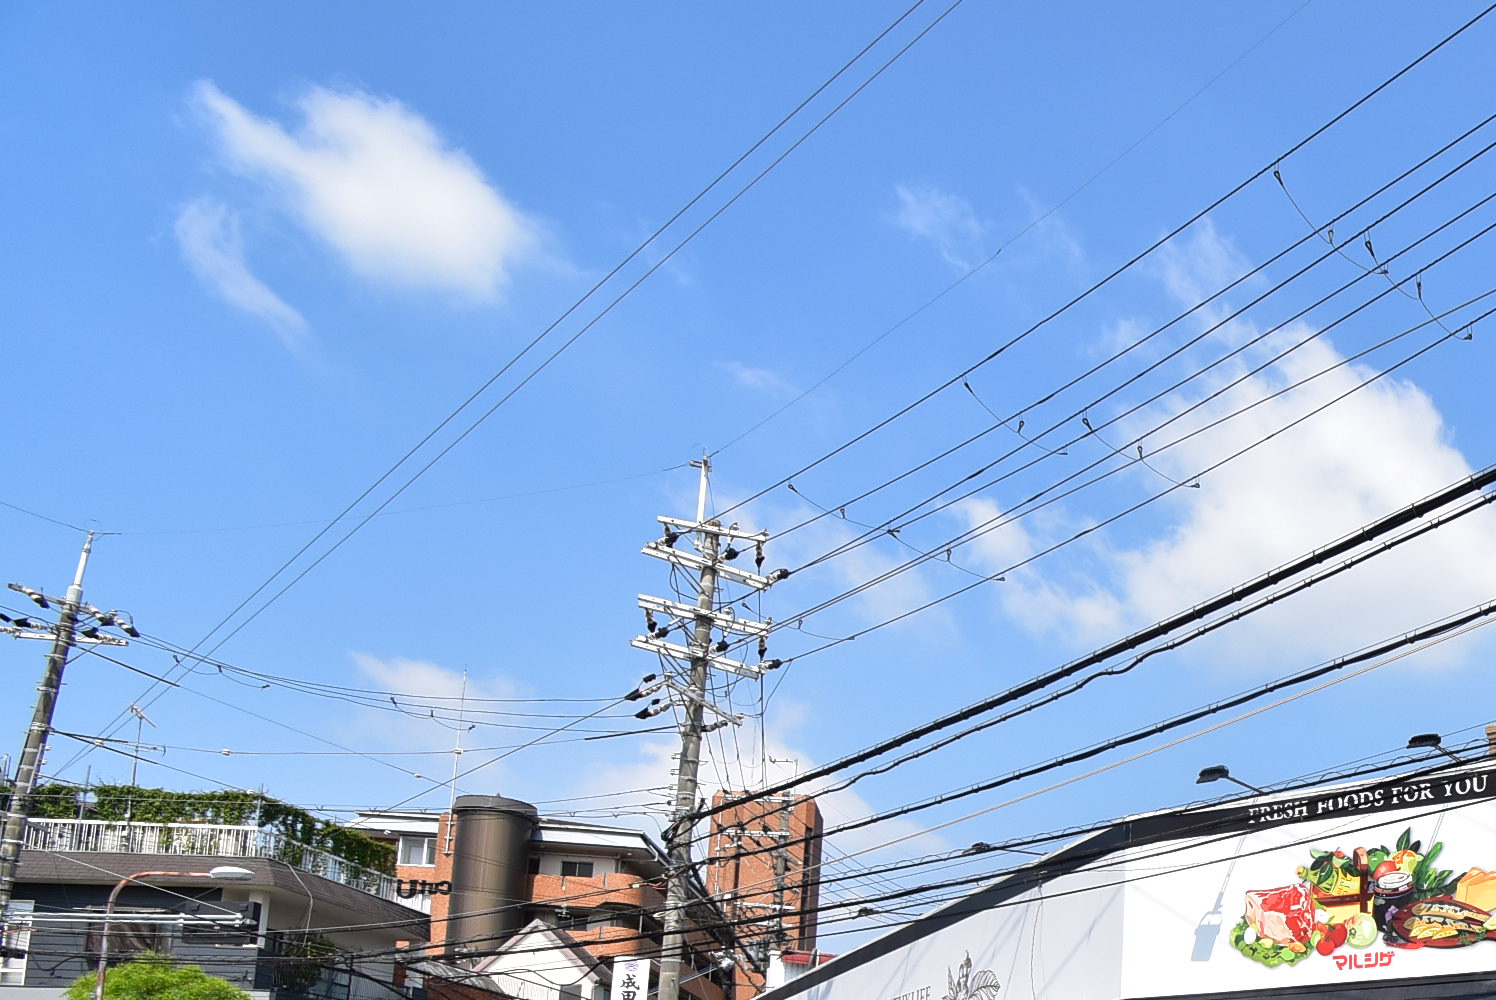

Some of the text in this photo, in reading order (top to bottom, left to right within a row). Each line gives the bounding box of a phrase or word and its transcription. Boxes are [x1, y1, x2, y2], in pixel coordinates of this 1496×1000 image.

[1247, 774, 1488, 824] FRESH FOODS FOR YOU
[1332, 950, 1396, 971] マルシゲ
